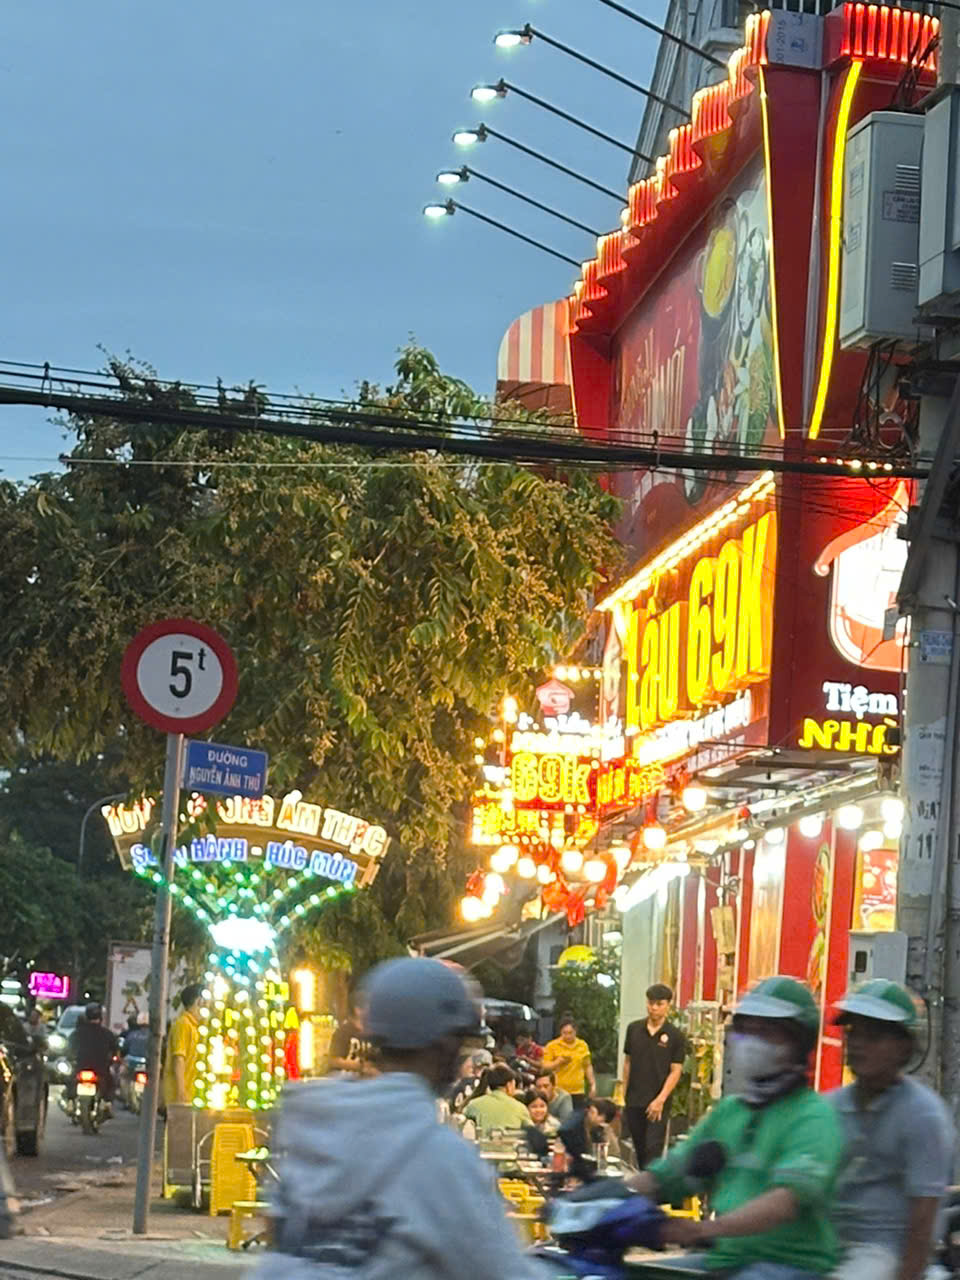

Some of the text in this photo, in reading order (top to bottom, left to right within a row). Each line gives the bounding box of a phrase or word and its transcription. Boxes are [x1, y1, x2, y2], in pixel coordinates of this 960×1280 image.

[687, 511, 769, 706] 69K
[822, 681, 899, 720] Tiệm
[207, 750, 249, 768] ĐƯỜNG
[189, 763, 223, 785] NGUYỄN
[223, 767, 242, 788] ẢNH
